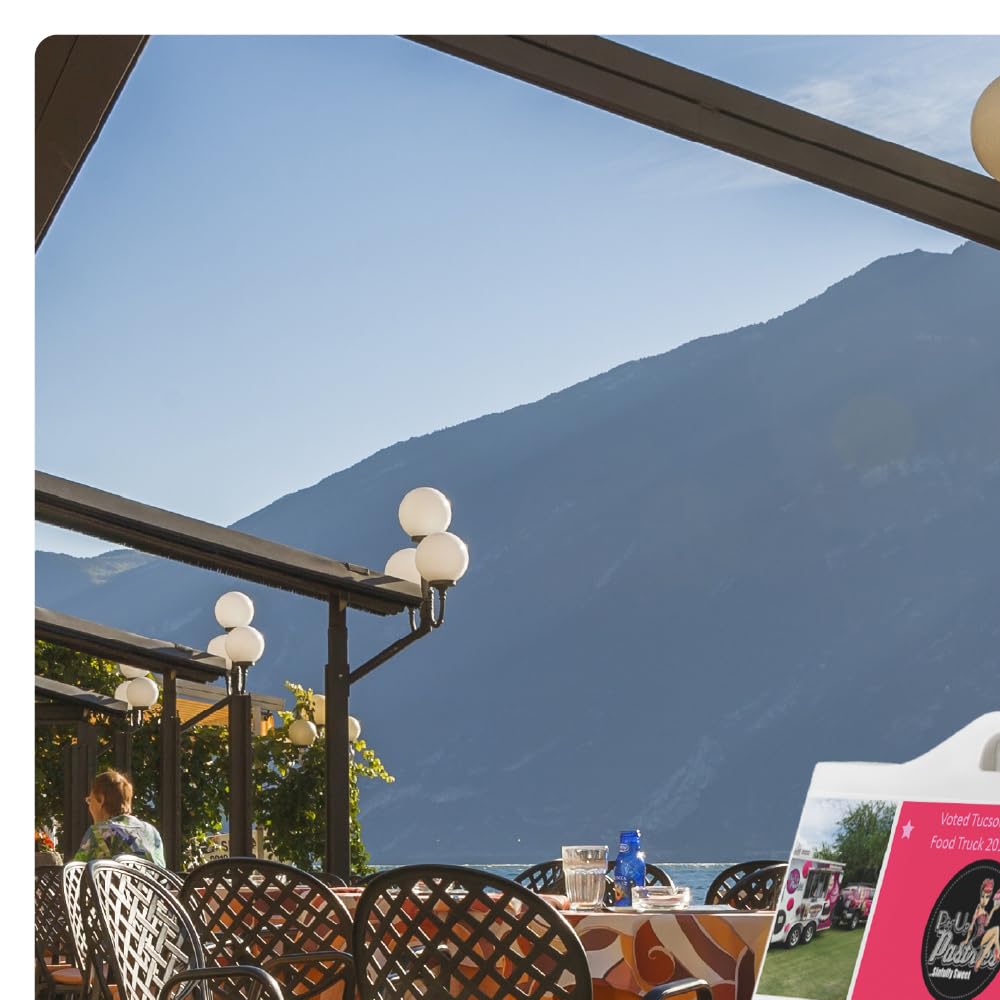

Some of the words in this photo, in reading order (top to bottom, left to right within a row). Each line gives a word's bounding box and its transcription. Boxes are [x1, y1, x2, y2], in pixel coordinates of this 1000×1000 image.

[940, 811, 971, 827] Voted
[930, 835, 957, 850] Food
[958, 836, 985, 852] Truck
[927, 929, 999, 969] Pastres
